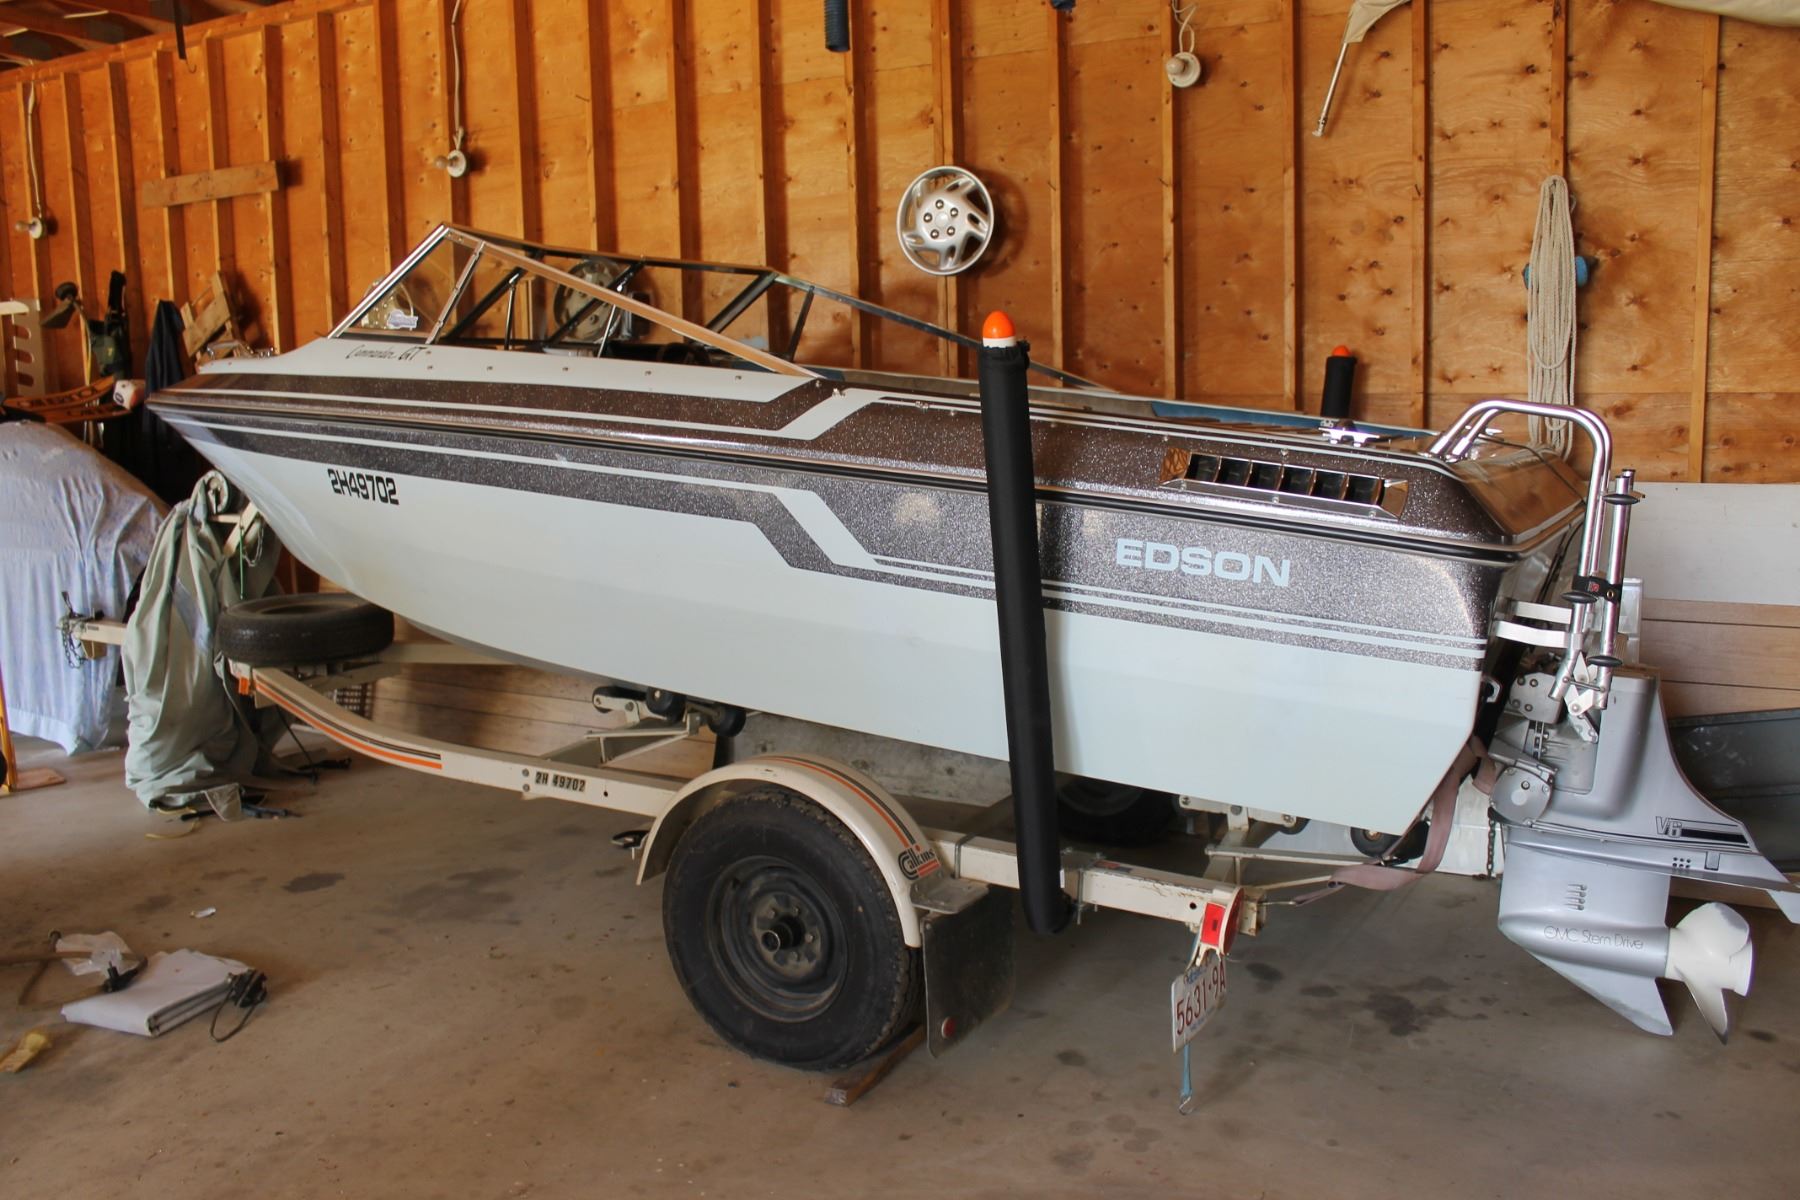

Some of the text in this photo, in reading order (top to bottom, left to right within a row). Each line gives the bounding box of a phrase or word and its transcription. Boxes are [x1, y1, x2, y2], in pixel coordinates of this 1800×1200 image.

[327, 468, 400, 506] 2H49702
[1116, 537, 1291, 588] EDSON
[535, 771, 586, 792] 2H 49702
[1655, 815, 1682, 838] V6
[1543, 925, 1644, 949] OMC Stern Drive
